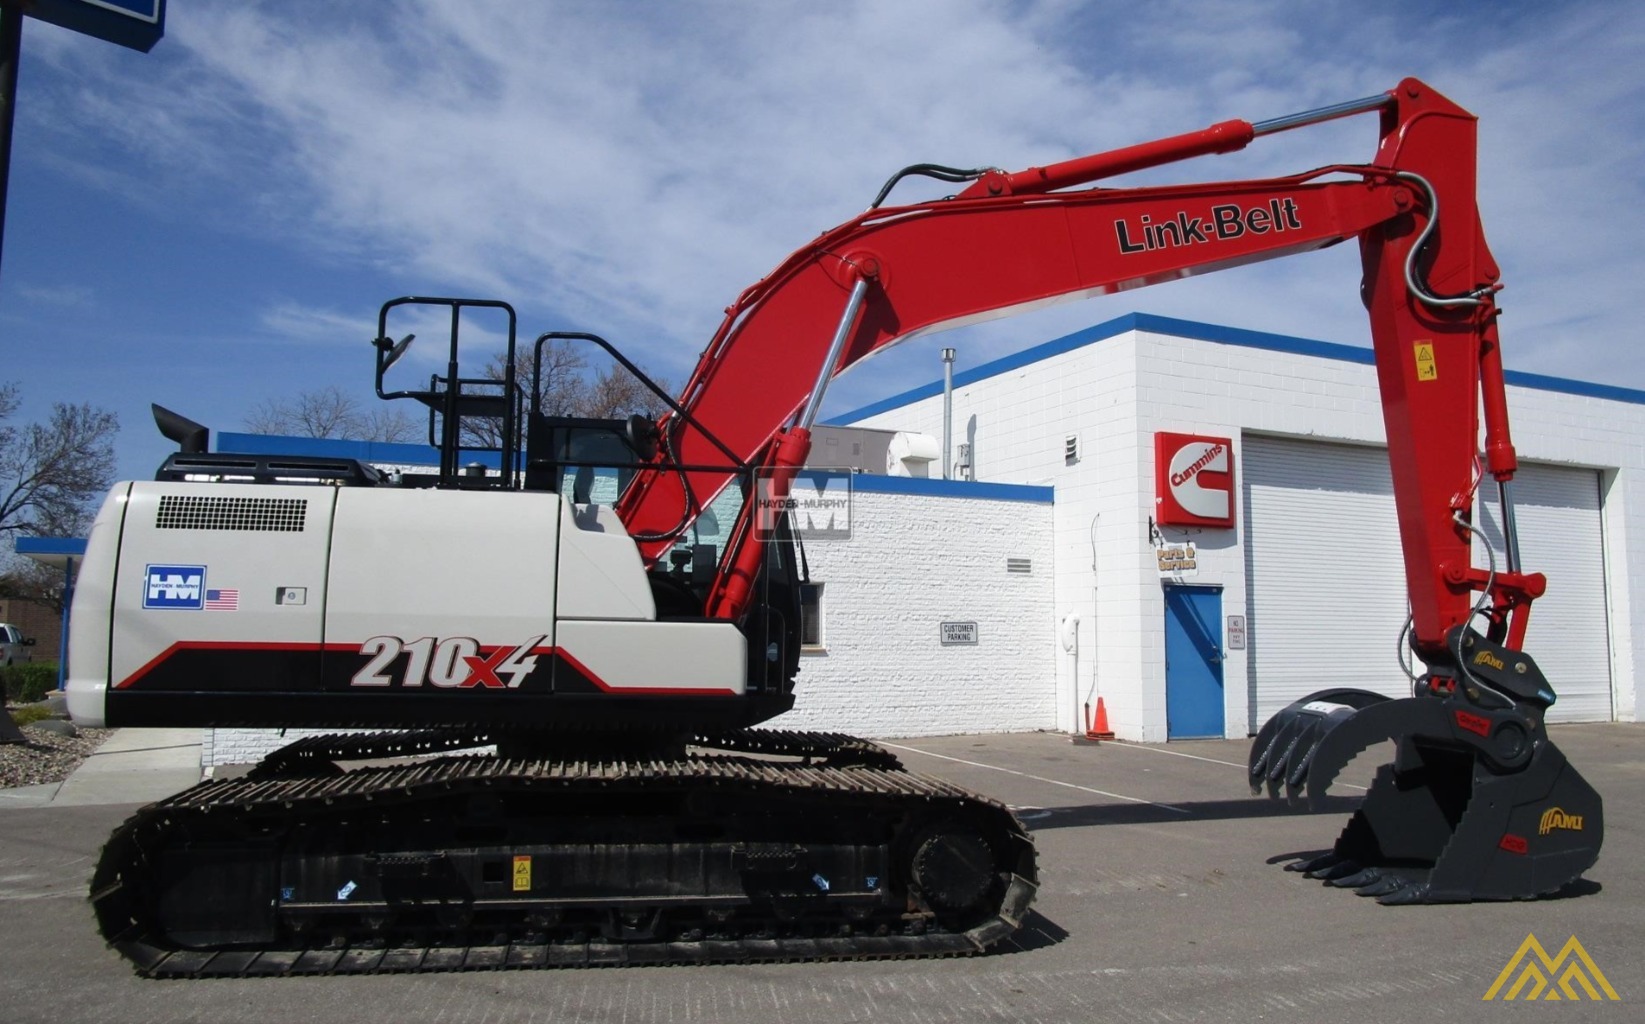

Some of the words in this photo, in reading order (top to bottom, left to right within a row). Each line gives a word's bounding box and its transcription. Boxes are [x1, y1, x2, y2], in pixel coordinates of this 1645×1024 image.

[1114, 198, 1301, 254] Link-Belt
[1171, 444, 1223, 487] Cummins
[1157, 549, 1185, 560] Parts
[1158, 560, 1196, 571] Service
[943, 624, 974, 633] CUSTOMER
[947, 633, 971, 641] PARKING
